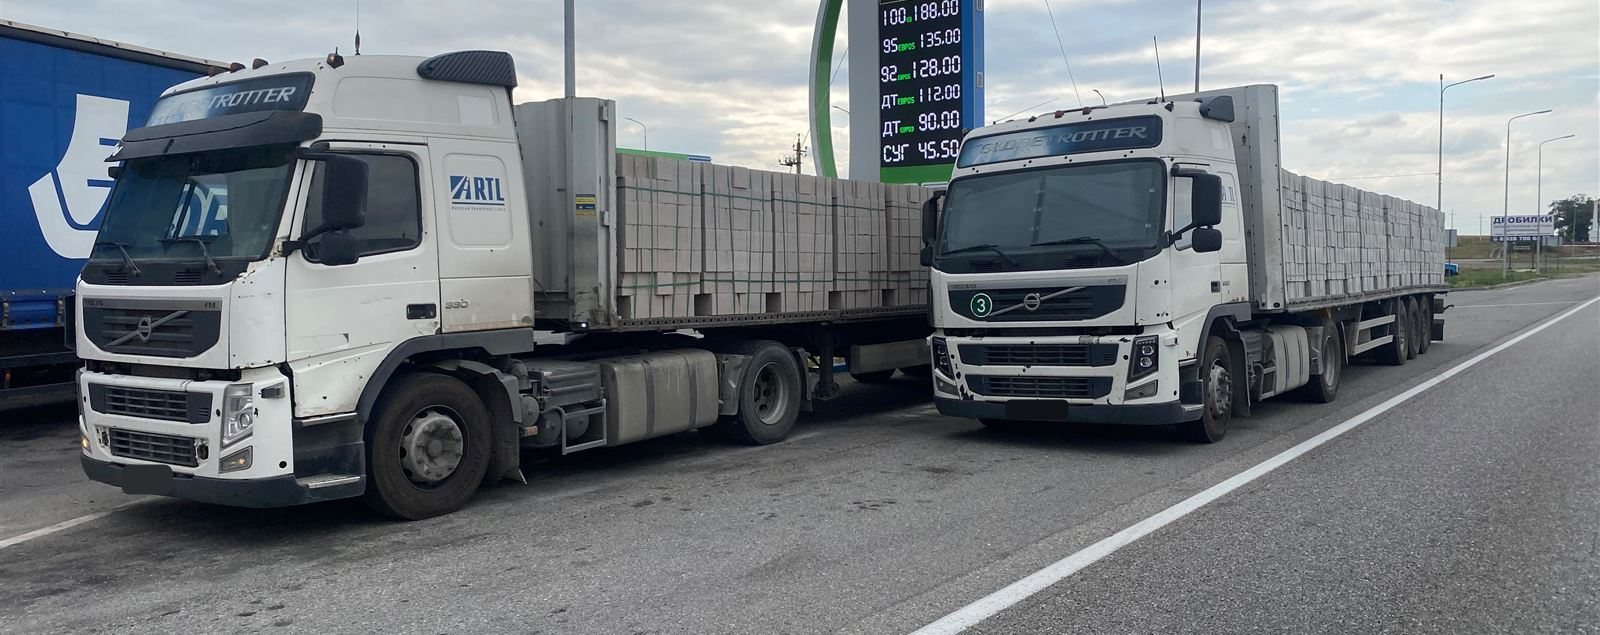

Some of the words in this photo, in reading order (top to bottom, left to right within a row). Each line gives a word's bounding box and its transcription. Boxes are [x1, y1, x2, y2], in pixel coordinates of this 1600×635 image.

[883, 7, 906, 26] 100
[883, 37, 898, 53] 95
[881, 65, 897, 82] 92
[881, 94, 898, 109] ДТ
[882, 120, 901, 137] ДТ
[981, 126, 1148, 154] GLOBETROTTER
[883, 144, 910, 162] СУГ
[451, 176, 505, 201] ARTL
[977, 299, 986, 313] 3
